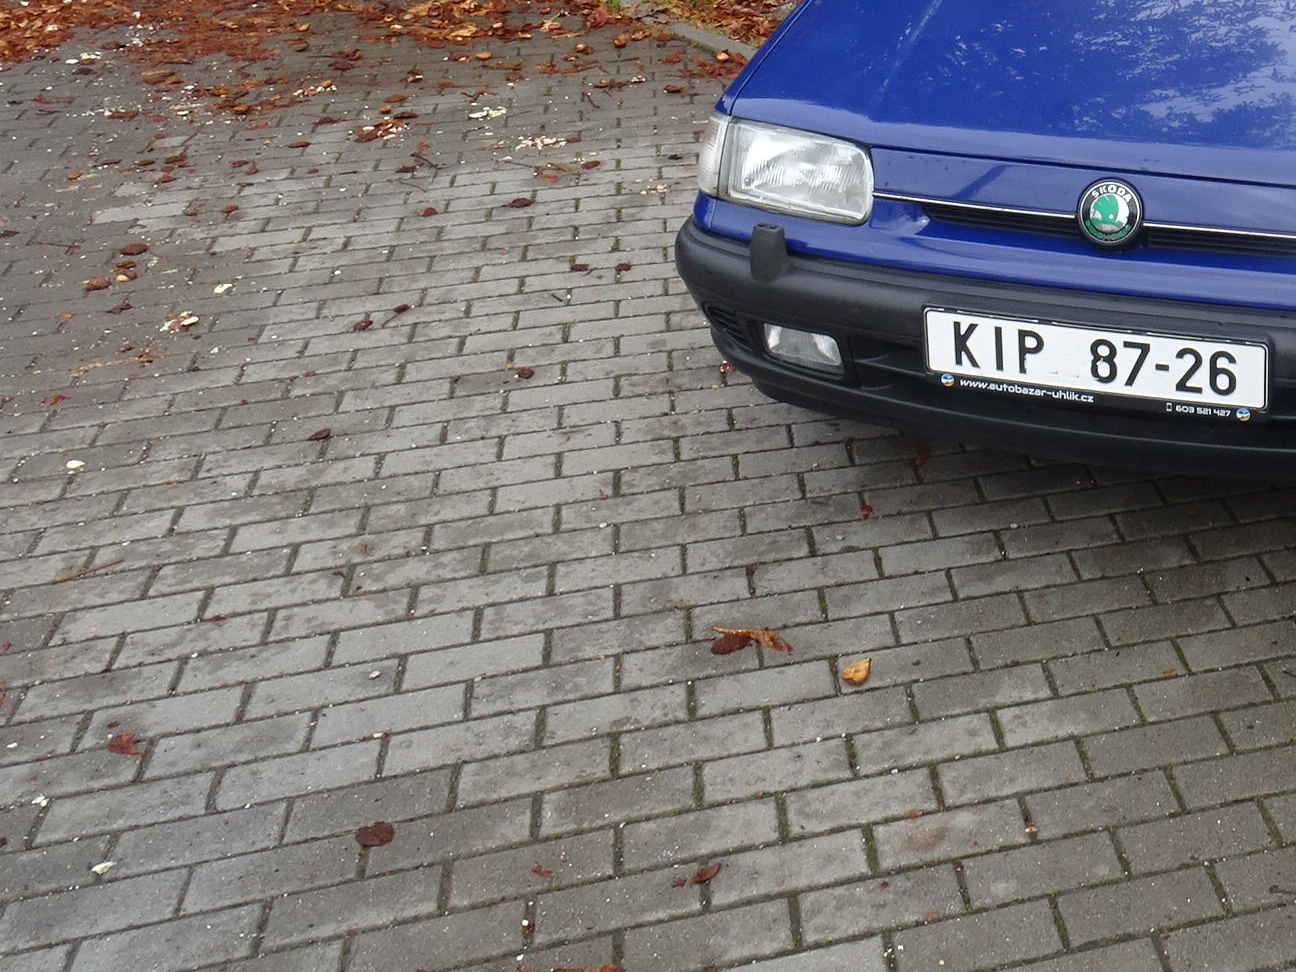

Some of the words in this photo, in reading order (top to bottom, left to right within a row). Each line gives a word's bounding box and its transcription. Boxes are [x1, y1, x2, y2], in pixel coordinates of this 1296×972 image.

[952, 320, 1045, 375] KIP
[1089, 338, 1238, 396] 87-26
[959, 378, 1095, 403] www.autobazar-uhlik.cz
